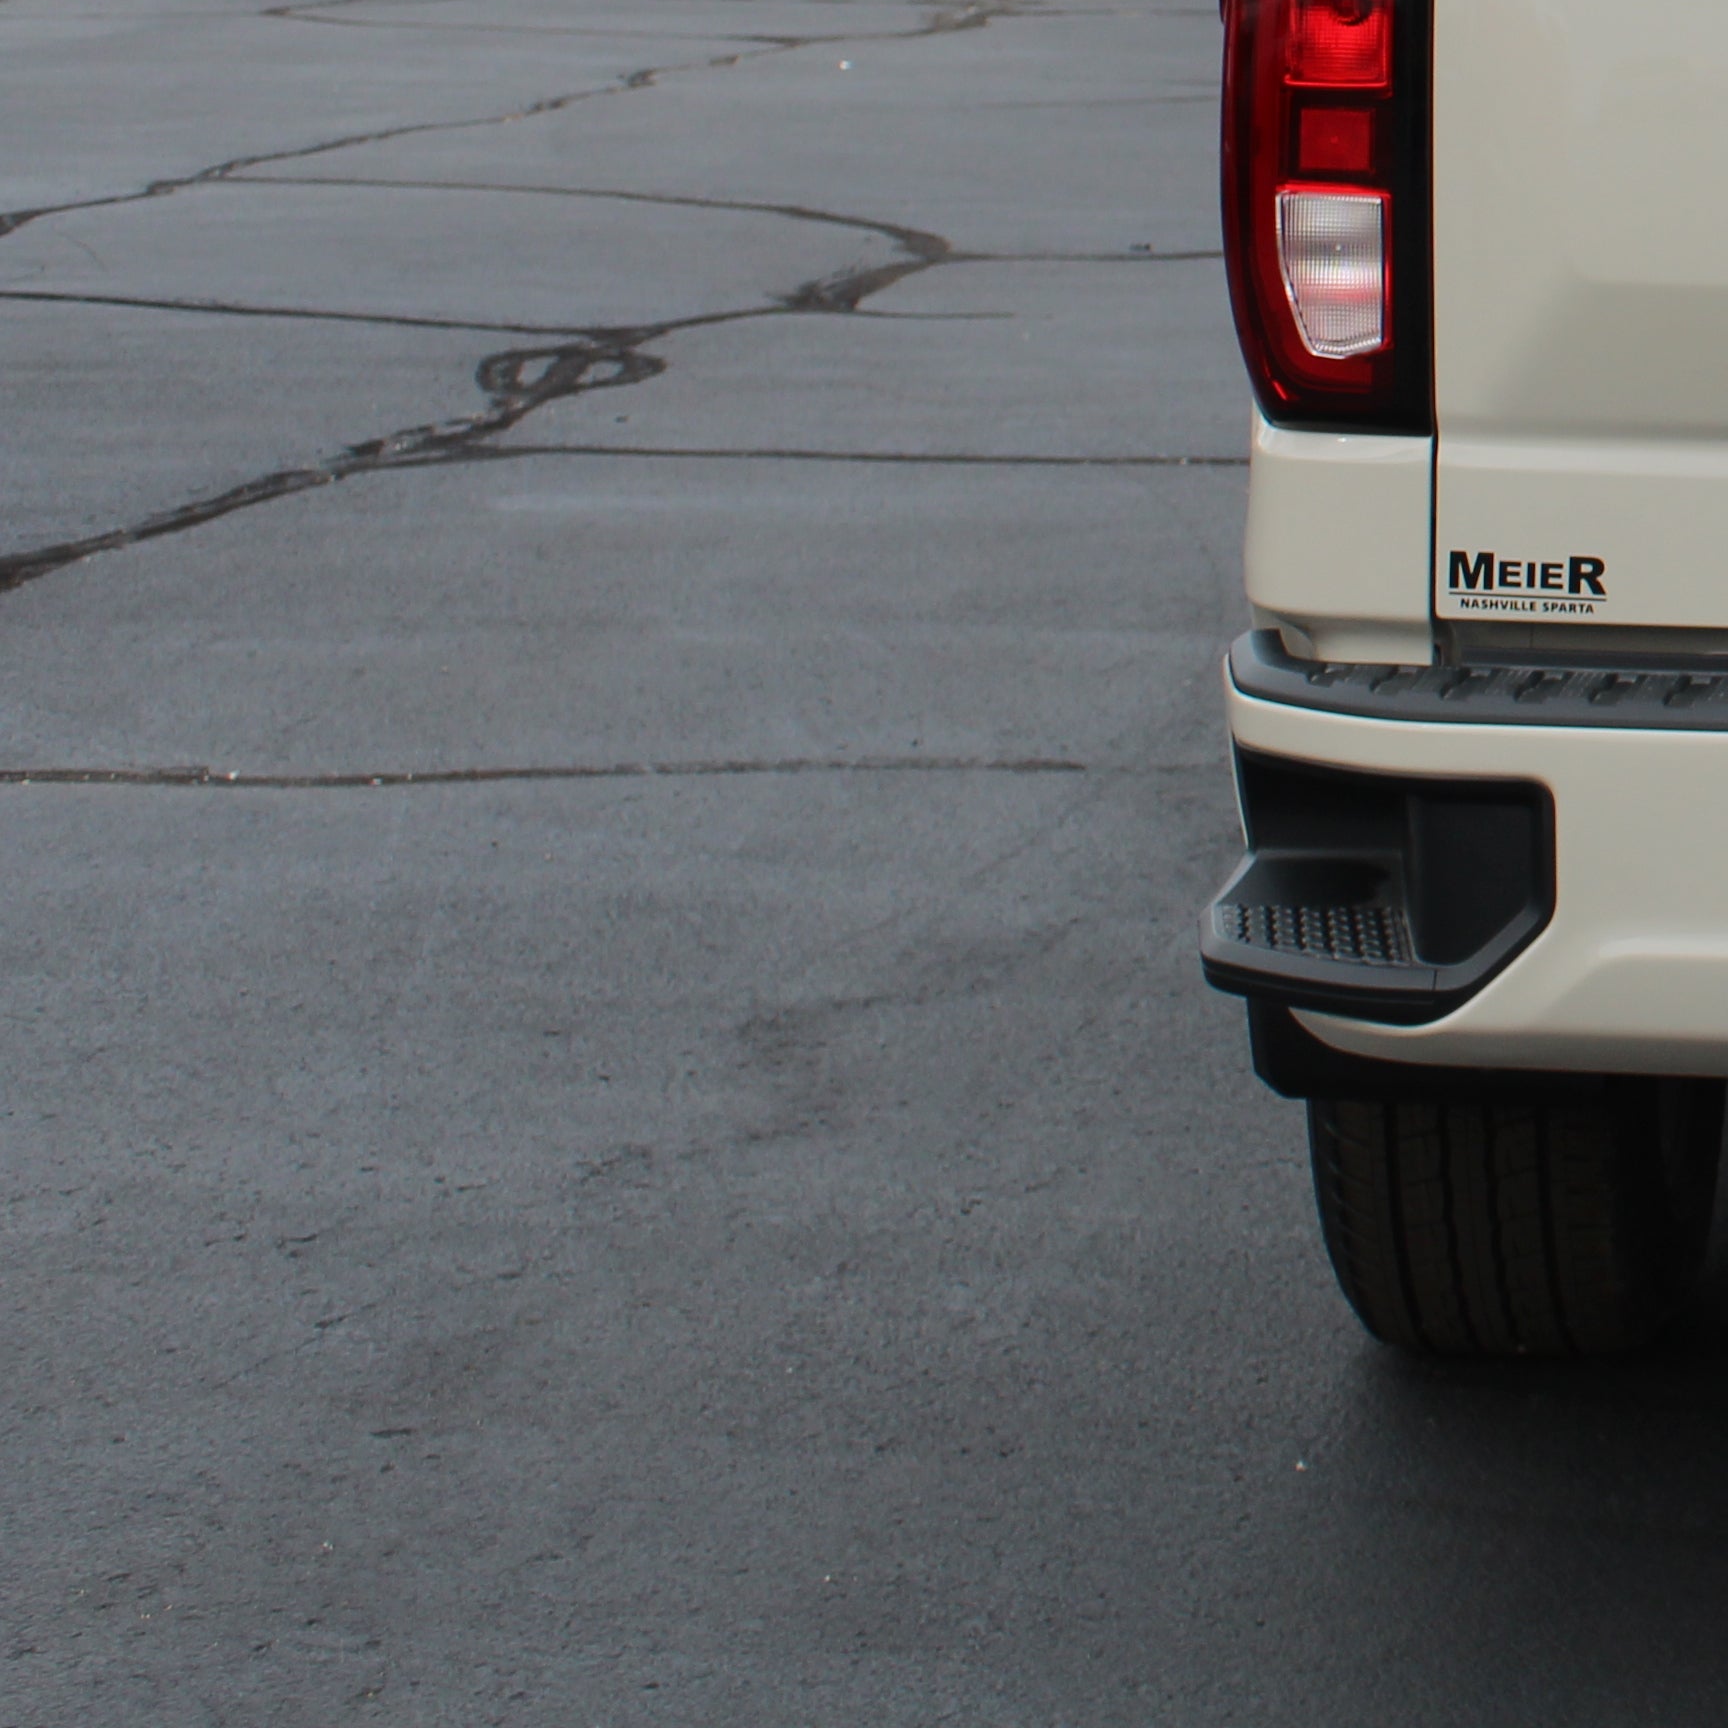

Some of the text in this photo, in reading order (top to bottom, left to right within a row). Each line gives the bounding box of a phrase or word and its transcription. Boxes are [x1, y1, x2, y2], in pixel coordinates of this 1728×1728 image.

[1448, 550, 1607, 595] MEIER
[1460, 598, 1595, 614] NASHVILLE SPARTA
